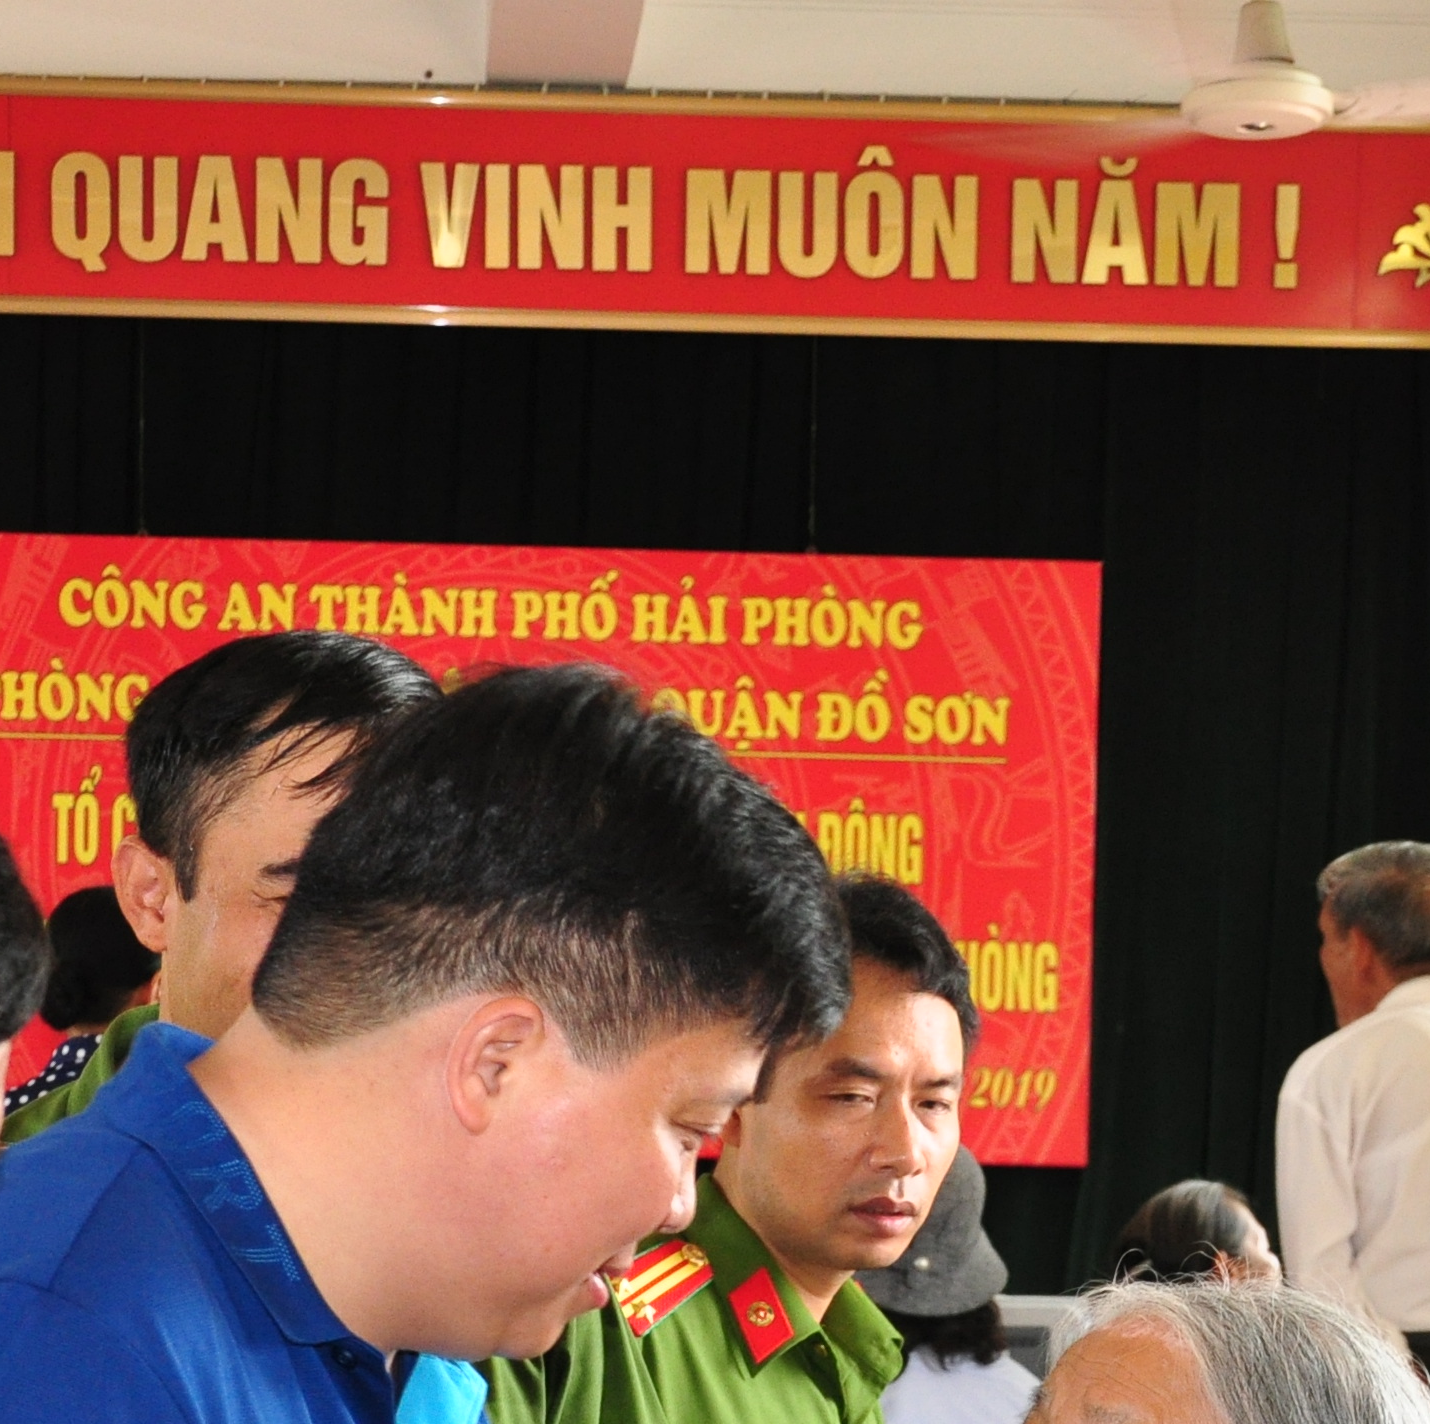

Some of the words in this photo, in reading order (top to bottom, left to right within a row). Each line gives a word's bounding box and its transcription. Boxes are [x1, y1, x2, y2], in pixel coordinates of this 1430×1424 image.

[50, 150, 390, 273] QUANG
[419, 161, 654, 273] VINH
[683, 145, 980, 281] MUÔN
[1010, 155, 1242, 288] NĂM
[1272, 183, 1301, 289] !
[59, 564, 207, 630] CÔNG
[217, 582, 298, 632] AN
[309, 572, 498, 638] THÀNH
[511, 569, 620, 642] PHỐ
[631, 575, 729, 645] HẢI
[741, 583, 924, 650] PHÒNG
[816, 668, 892, 743] ĐỒ
[903, 690, 1011, 746] SƠN
[52, 765, 102, 866] TỔ
[969, 1066, 1058, 1112] 2019
